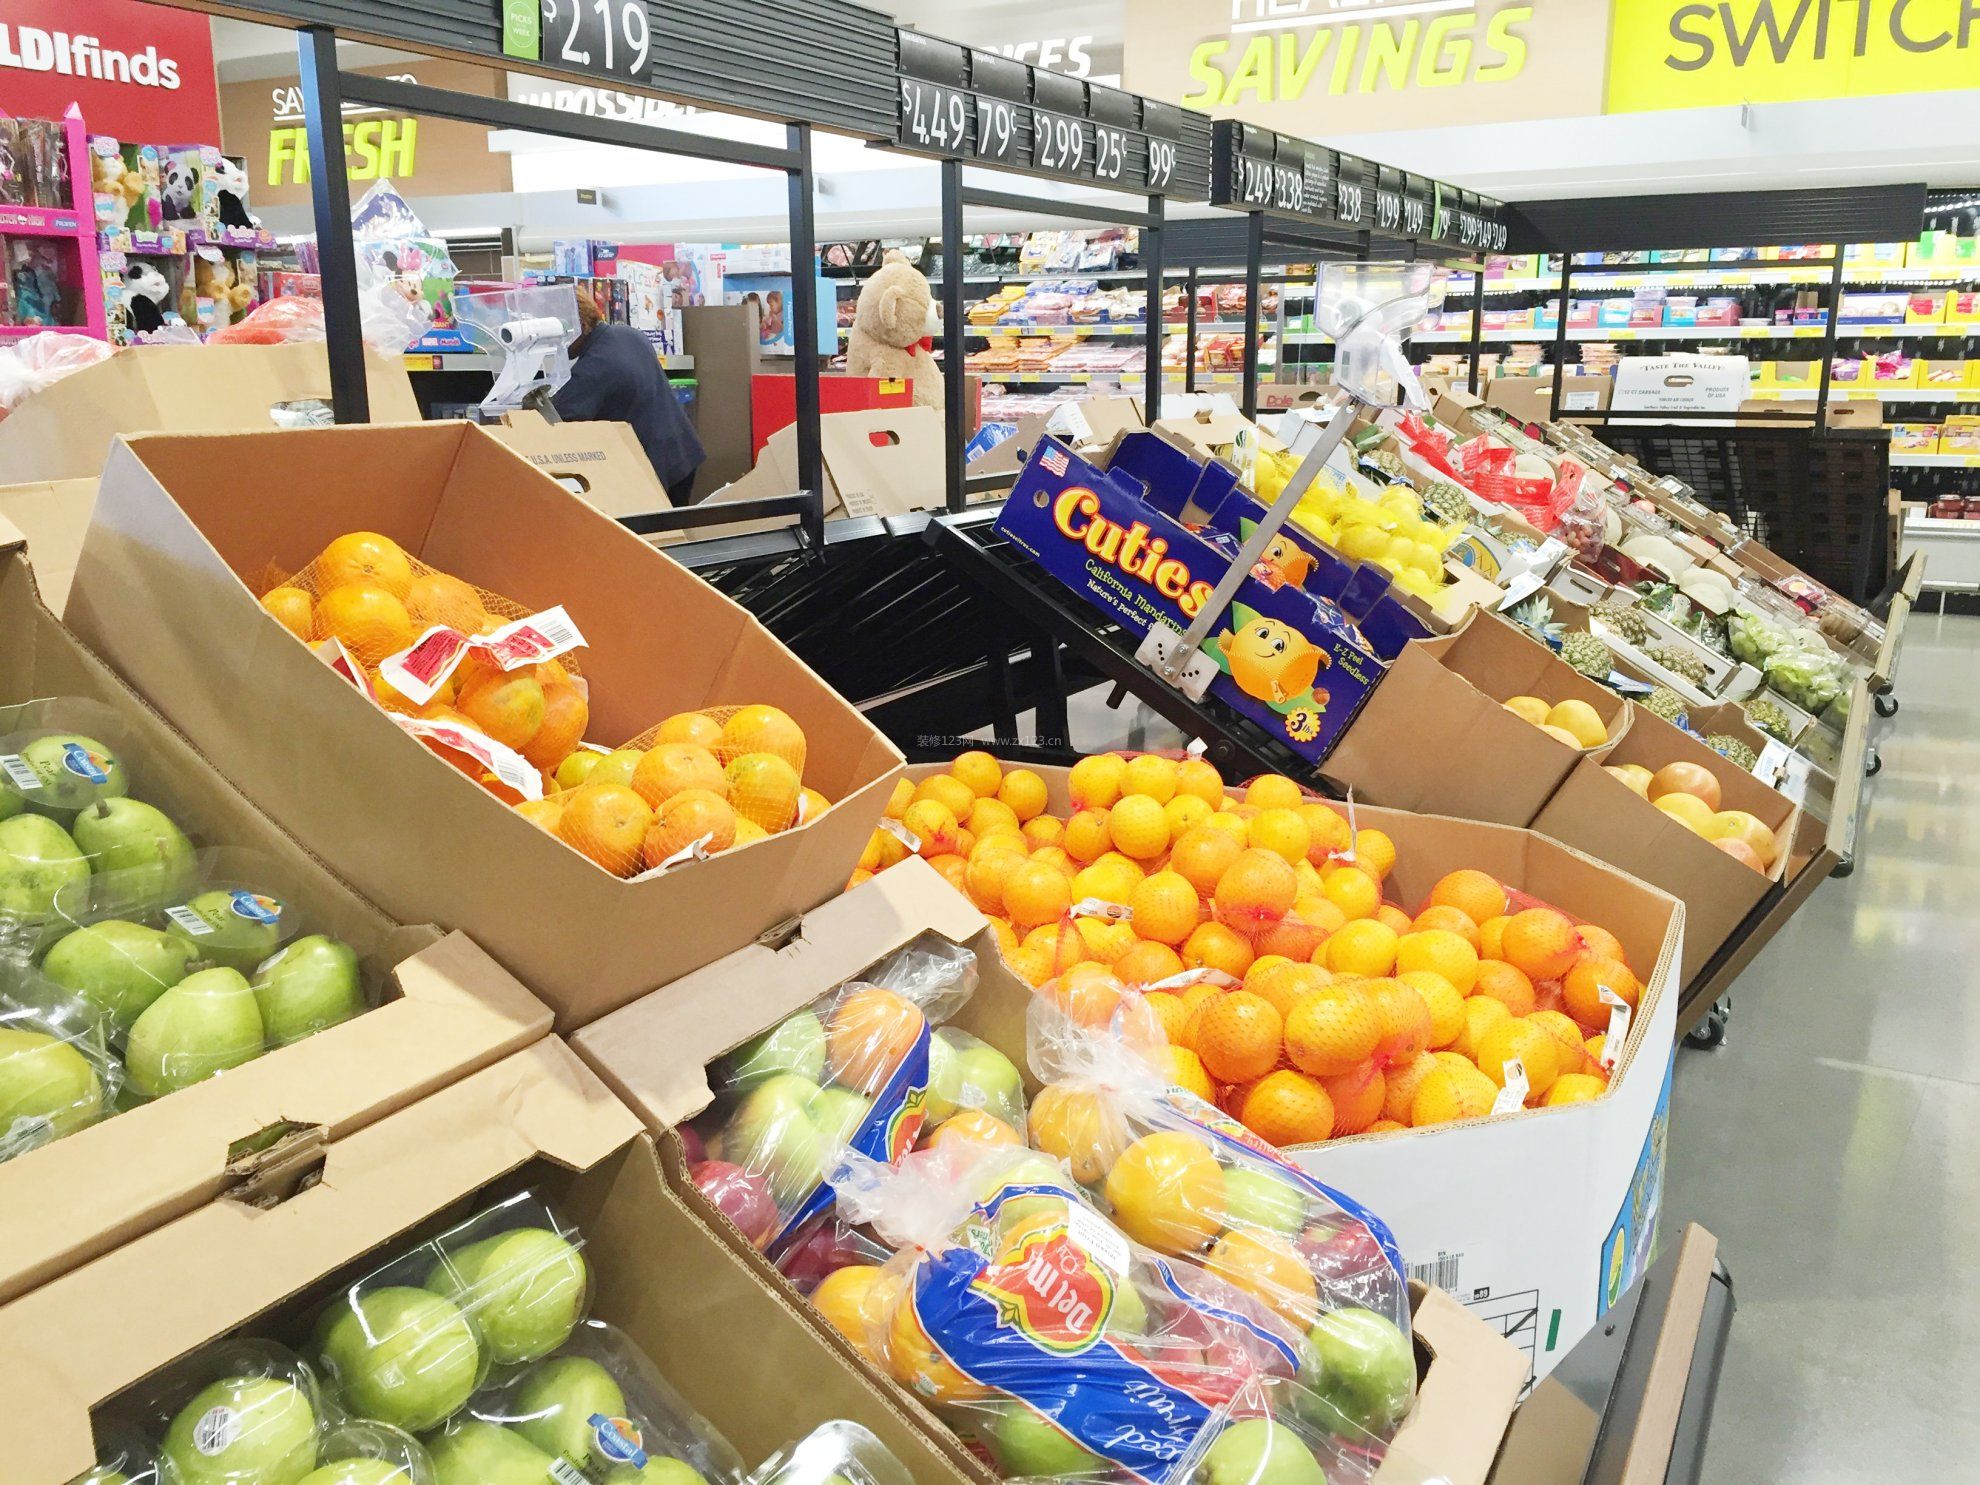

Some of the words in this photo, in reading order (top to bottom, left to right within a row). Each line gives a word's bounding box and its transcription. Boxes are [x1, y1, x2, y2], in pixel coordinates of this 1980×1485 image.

[980, 35, 1093, 79] ICES
[1180, 7, 1534, 109] SAVINGS
[903, 80, 965, 150] $4.49
[978, 100, 1018, 158] 79¢
[1096, 128, 1128, 180] 25¢
[1150, 140, 1176, 188] 99¢
[1644, 363, 1669, 372] TASTE
[1693, 362, 1722, 372] VALLEY
[551, 451, 579, 464] UNLESS
[578, 450, 607, 462] MARKED
[1053, 485, 1216, 621] Cuties
[1085, 558, 1133, 602] California
[1134, 593, 1188, 637] Mandarins
[1086, 578, 1119, 607] Nature's
[1333, 643, 1349, 657] E-Z
[1347, 650, 1364, 666] Peel
[1337, 657, 1370, 686] Seedless
[1290, 712, 1308, 733] 3
[600, 1421, 640, 1459] Coastal
